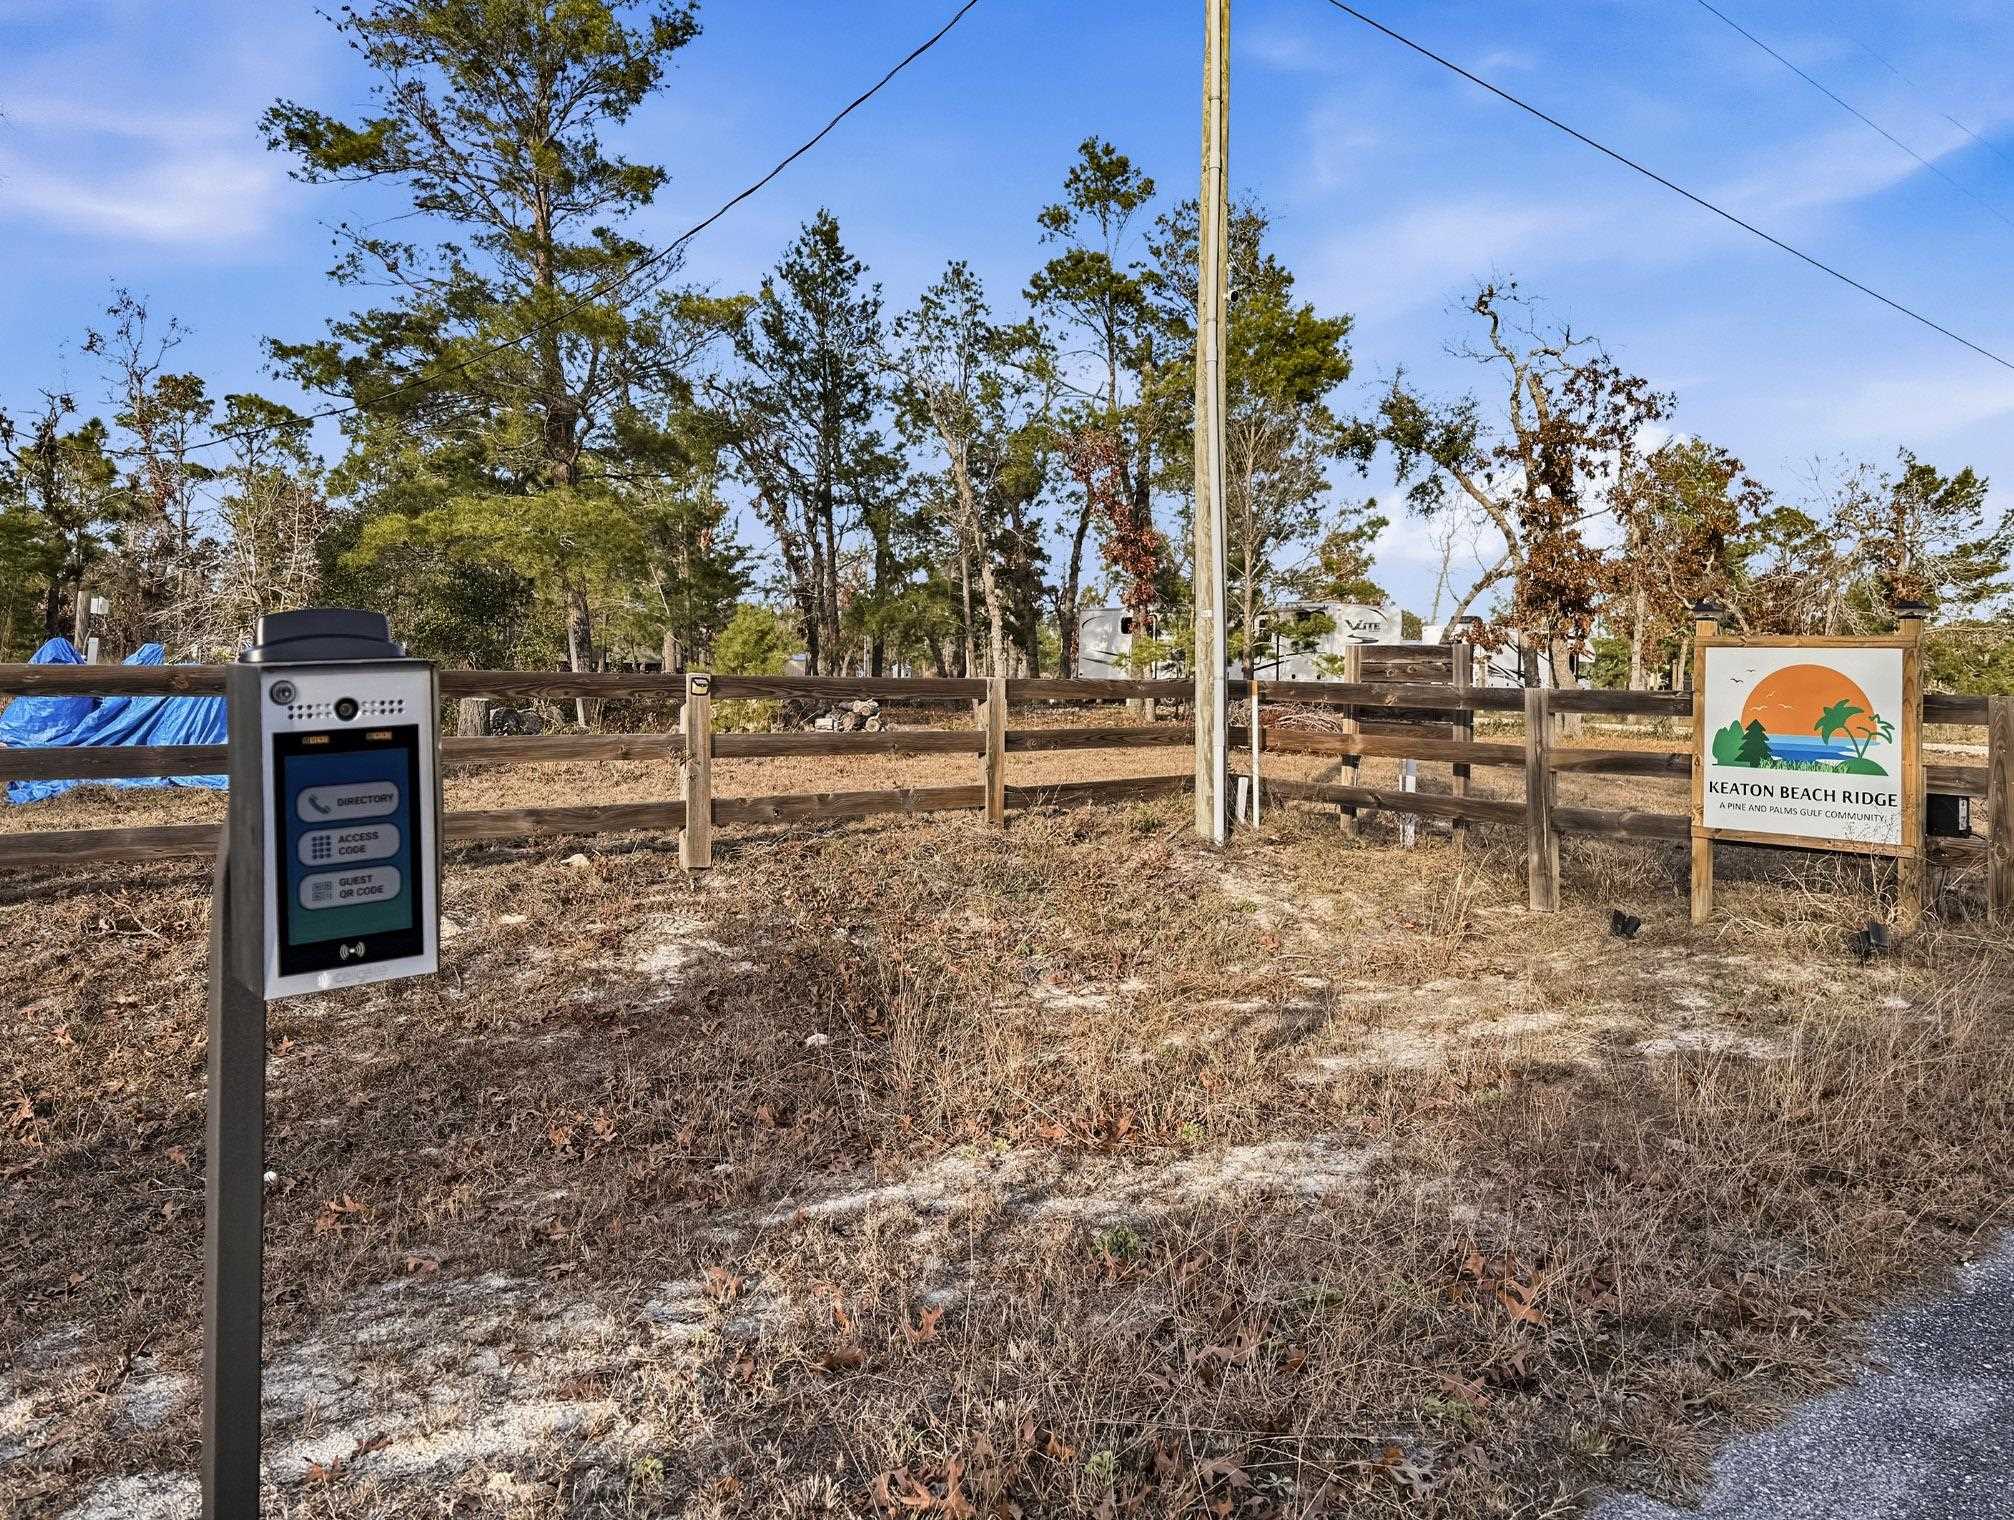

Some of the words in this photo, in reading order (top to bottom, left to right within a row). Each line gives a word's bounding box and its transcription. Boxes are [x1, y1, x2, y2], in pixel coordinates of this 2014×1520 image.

[336, 793, 394, 807] DIRECTORY
[1709, 781, 1774, 798] KEATON
[1780, 786, 1836, 803] BEACH
[1842, 790, 1898, 807] RIDGE
[1719, 801, 1726, 809] A
[1727, 802, 1746, 811] PINE
[1748, 804, 1767, 813] AND
[1769, 805, 1798, 816] PALMS
[1799, 808, 1822, 817] GULF
[338, 831, 379, 843] ACCESS
[338, 844, 366, 855] CODE
[339, 875, 373, 887] GUEST
[339, 888, 354, 899] QR
[356, 884, 384, 897] CODE
